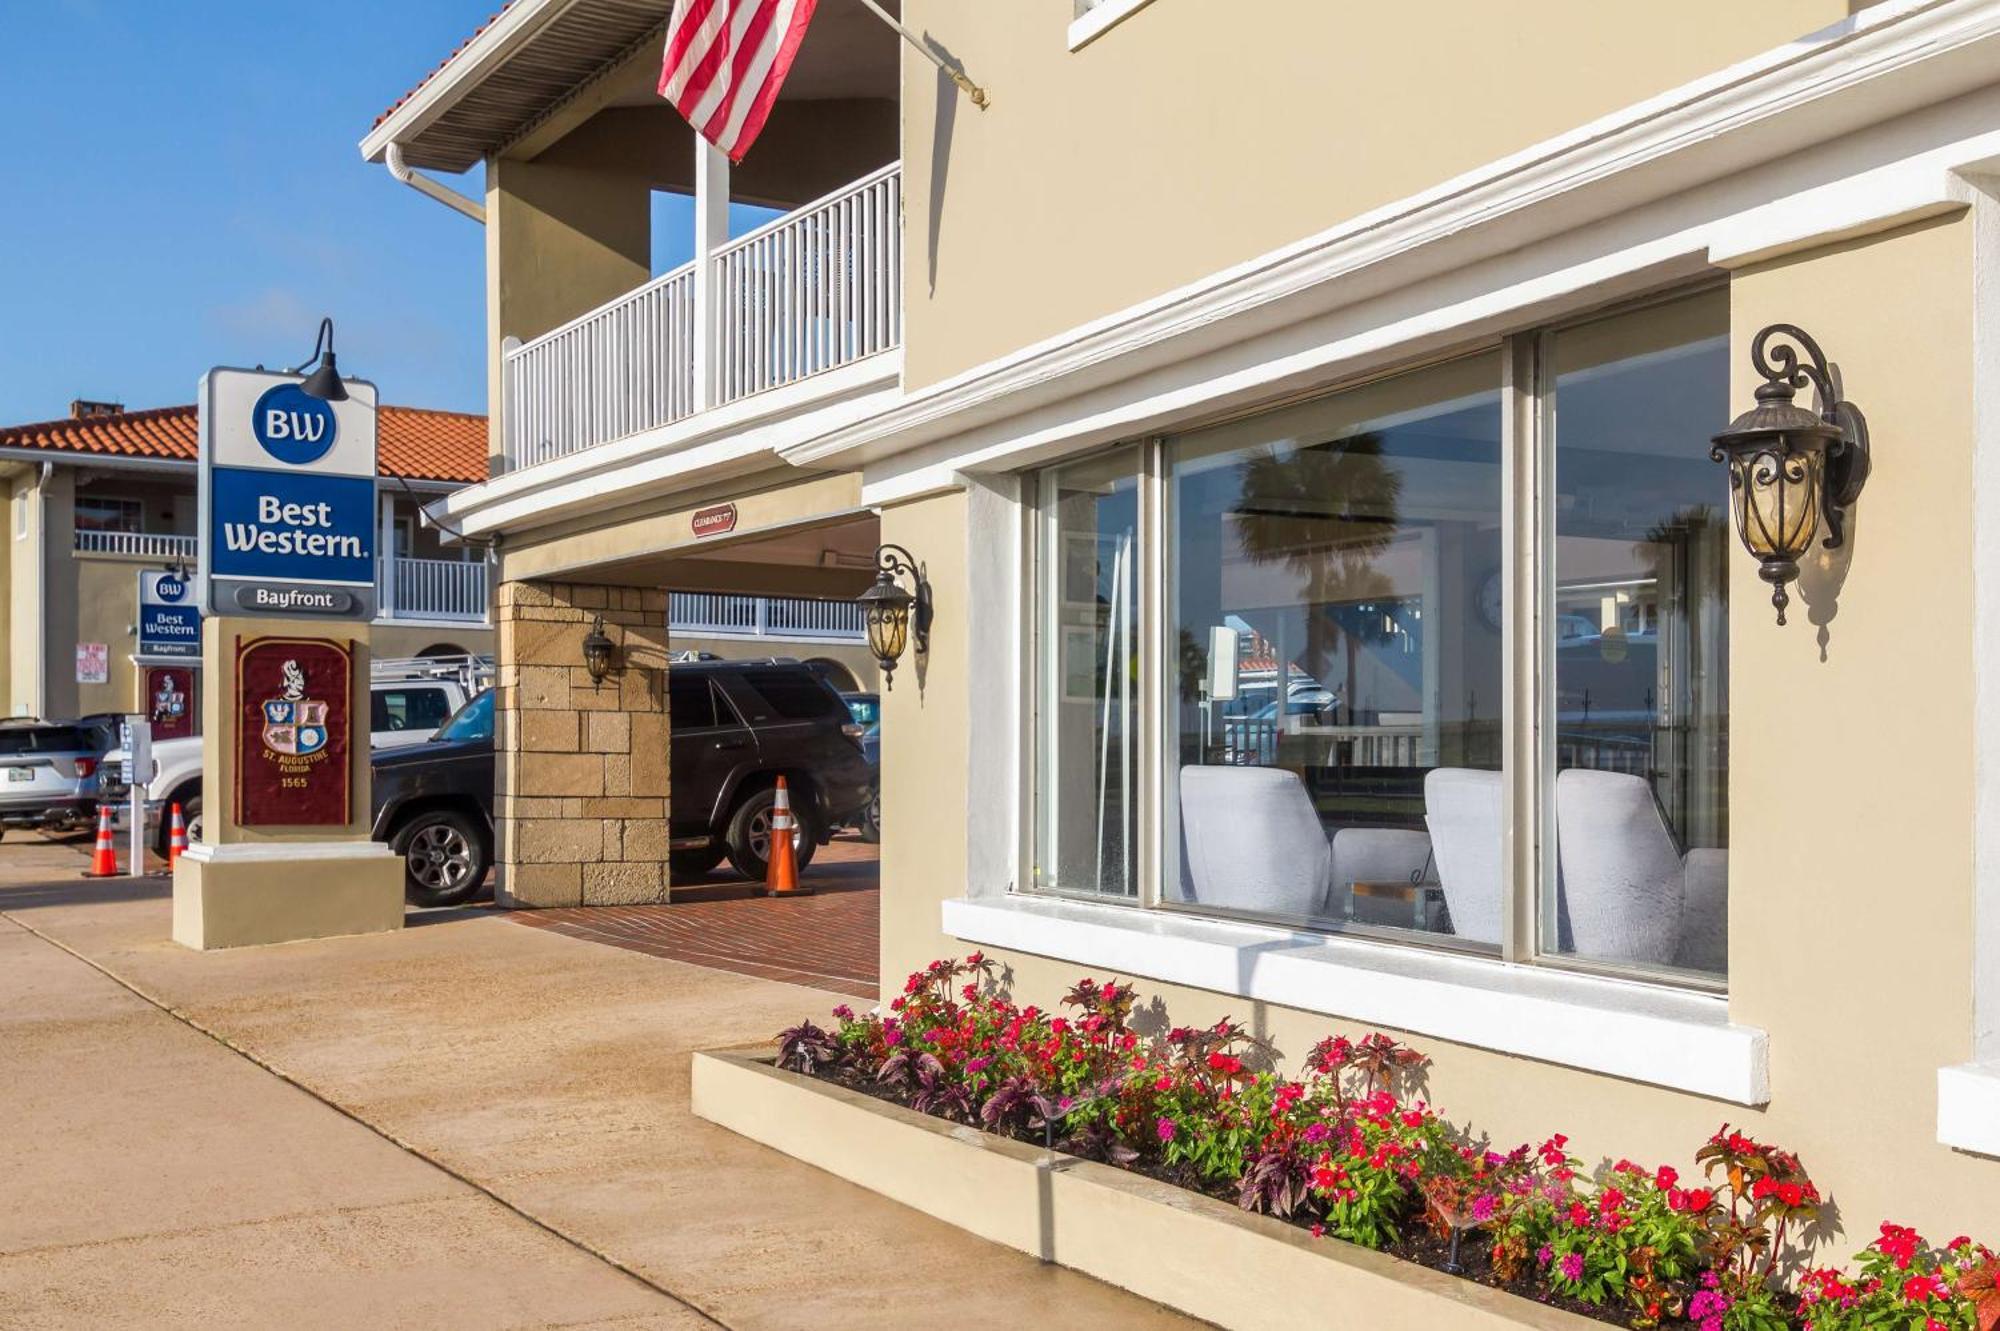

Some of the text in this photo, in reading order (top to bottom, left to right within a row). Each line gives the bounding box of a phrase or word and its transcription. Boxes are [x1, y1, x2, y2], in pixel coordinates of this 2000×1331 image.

[266, 409, 325, 442] BW
[258, 495, 332, 528] Best
[160, 583, 182, 596] BW
[256, 589, 334, 608] Bayfront
[157, 613, 183, 624] Best
[145, 622, 194, 635] Western
[278, 749, 328, 764] AUGUSTINE
[280, 765, 311, 773] FLORIDA
[282, 778, 308, 788] 1565
